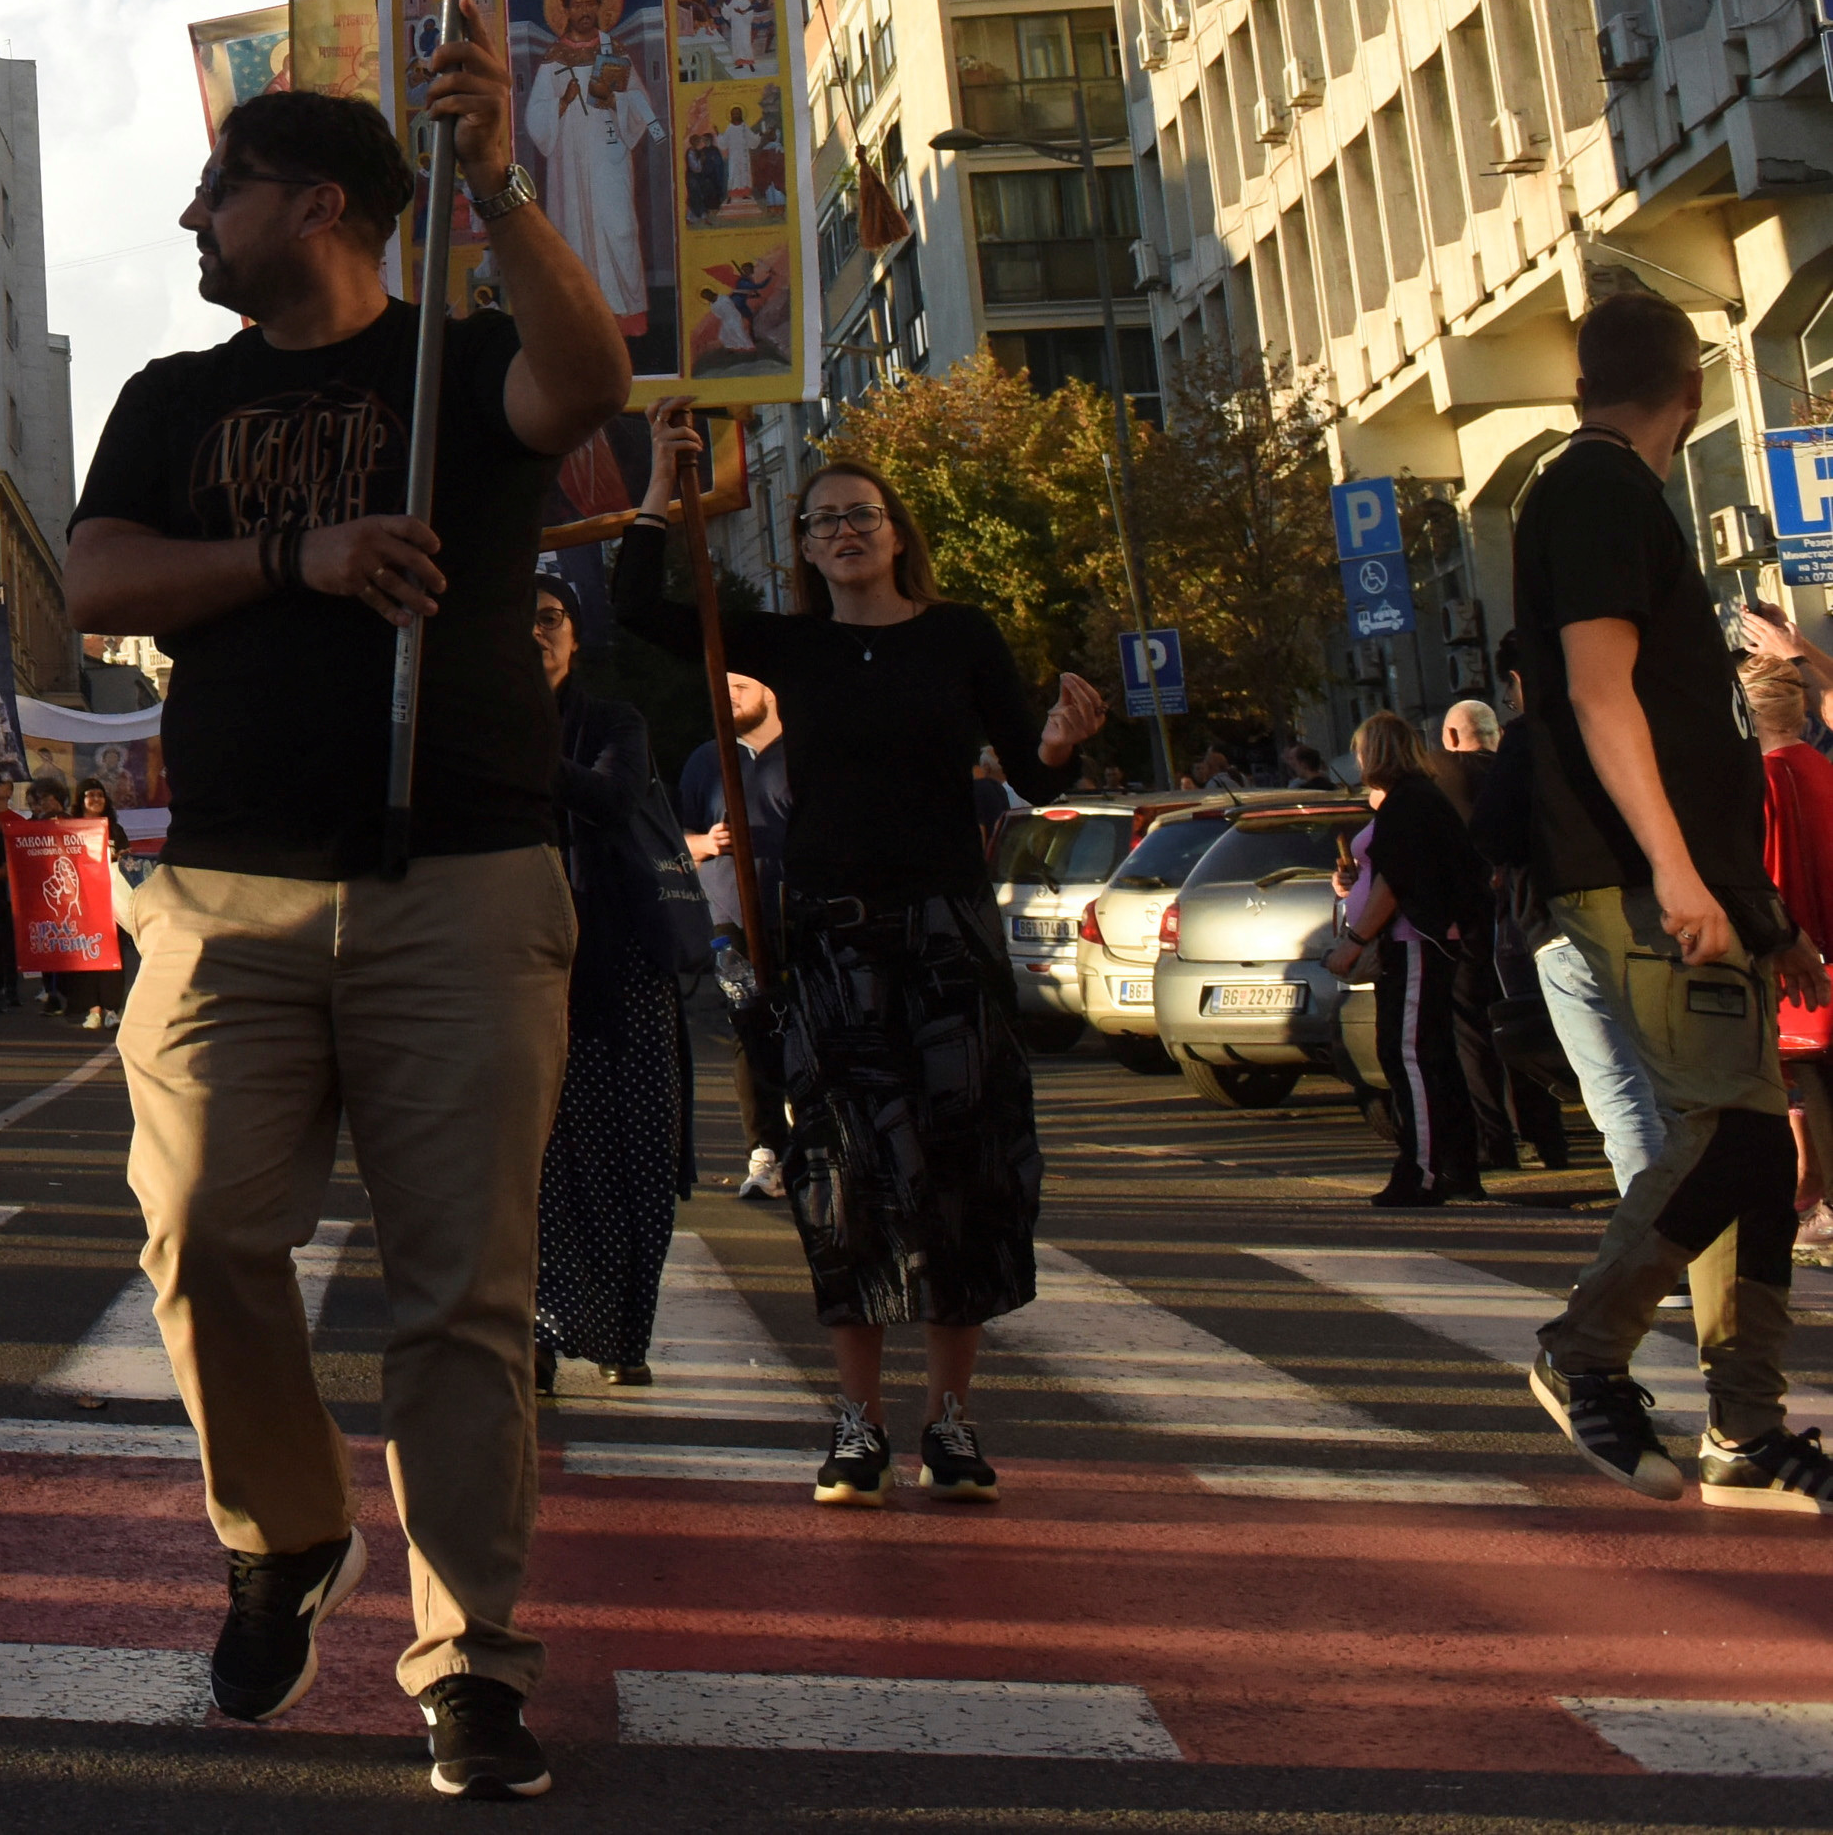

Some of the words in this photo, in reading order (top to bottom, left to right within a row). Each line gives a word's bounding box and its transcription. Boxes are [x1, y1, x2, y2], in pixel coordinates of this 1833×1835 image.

[1345, 488, 1383, 547] P
[1812, 561, 1820, 571] 3
[1133, 638, 1167, 684] P
[1129, 983, 1142, 999] BG
[1222, 989, 1239, 1006] BG
